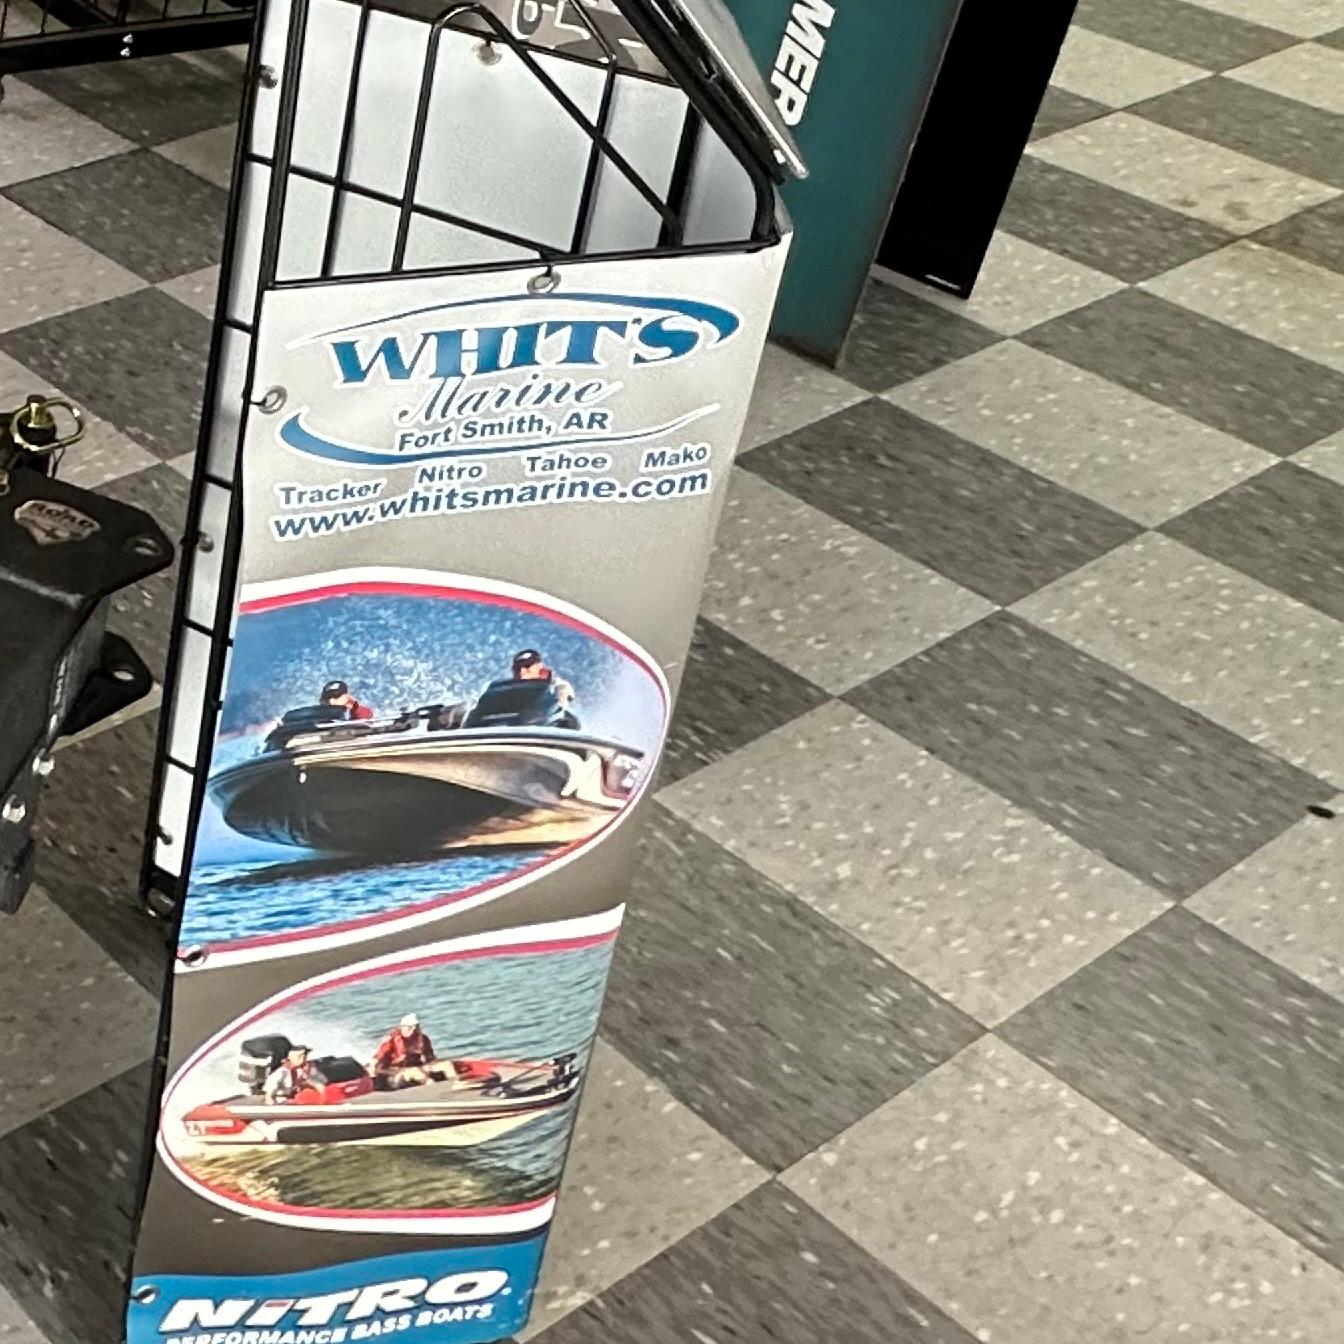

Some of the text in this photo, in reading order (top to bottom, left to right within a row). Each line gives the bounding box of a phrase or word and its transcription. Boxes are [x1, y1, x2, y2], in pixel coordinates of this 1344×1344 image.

[329, 316, 702, 384] WHIT'S
[398, 372, 608, 424] Marine
[398, 410, 611, 453] Fort Smith, AR
[273, 469, 710, 540] www.whitsmarine.com
[280, 445, 709, 507] Tracker Nitro Tahoe Mako
[350, 1314, 412, 1339] BASS
[414, 1302, 496, 1327] BOATS
